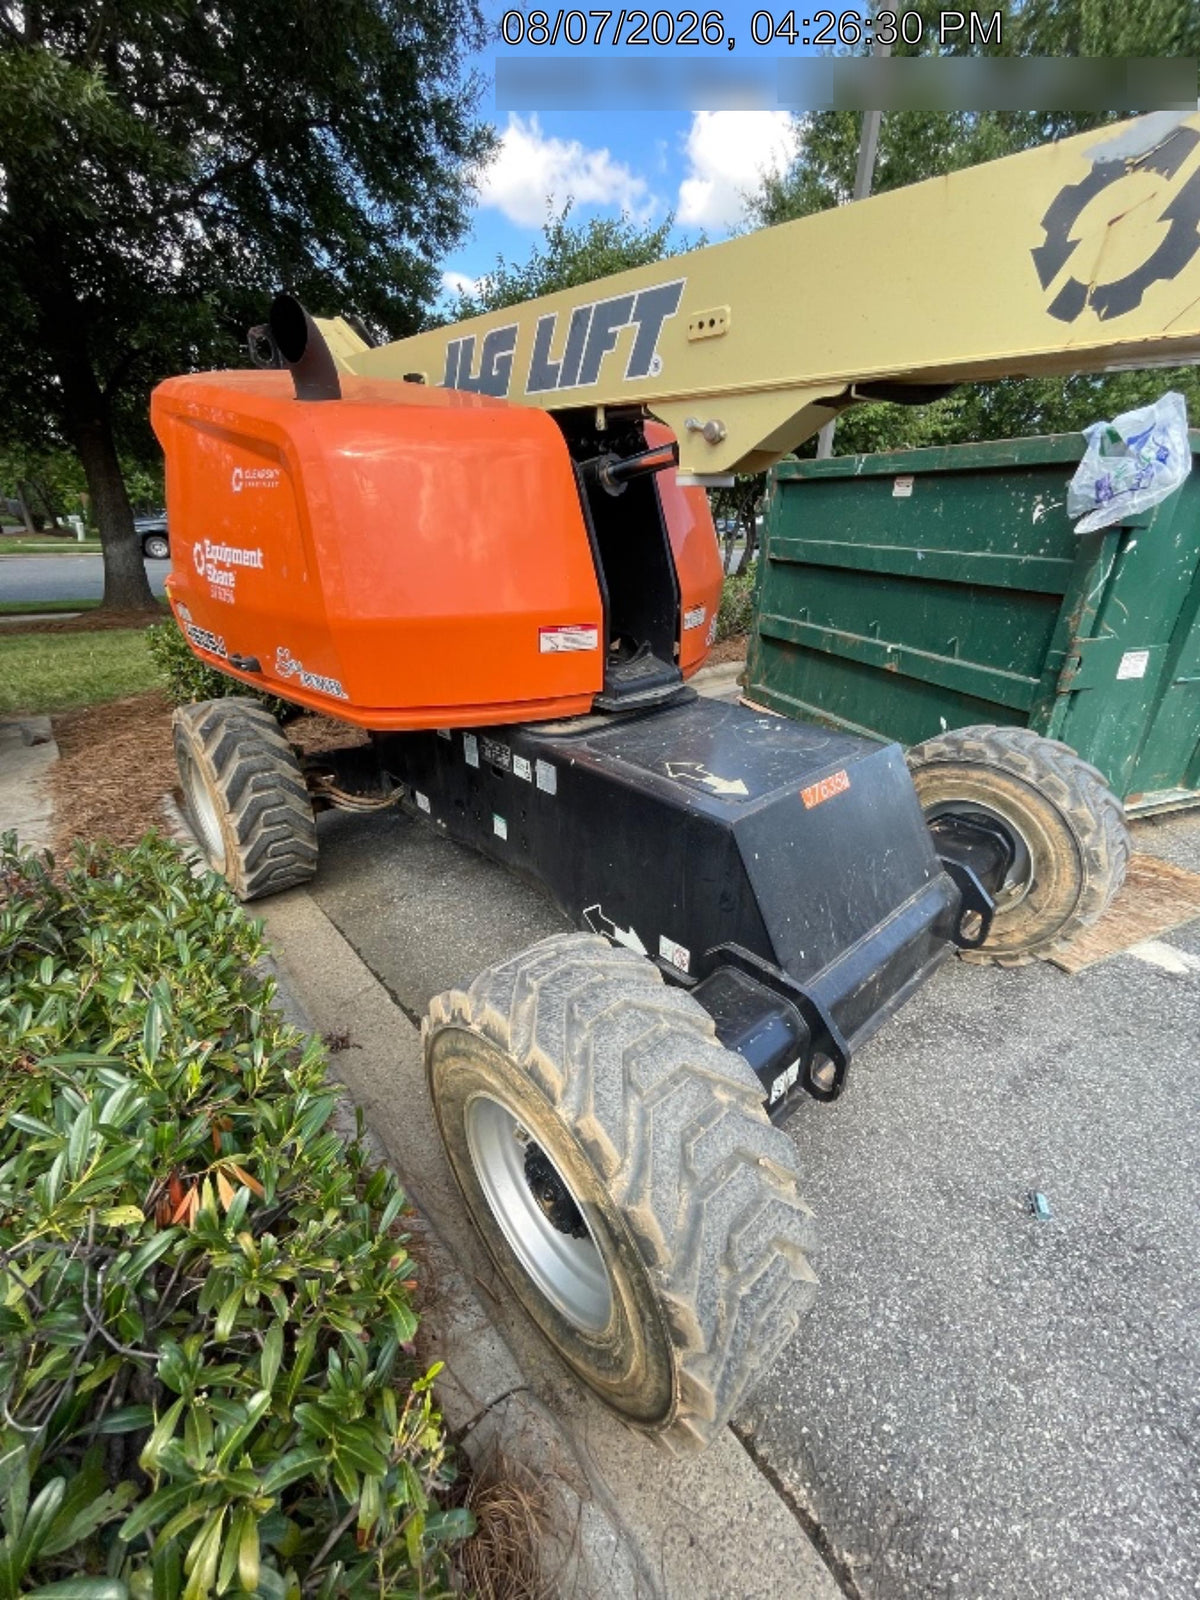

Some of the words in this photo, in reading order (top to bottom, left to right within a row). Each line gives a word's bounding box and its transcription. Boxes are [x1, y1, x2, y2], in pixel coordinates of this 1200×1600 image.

[524, 277, 688, 395] LIFT
[204, 539, 264, 570] Equipment
[206, 563, 236, 588] Share
